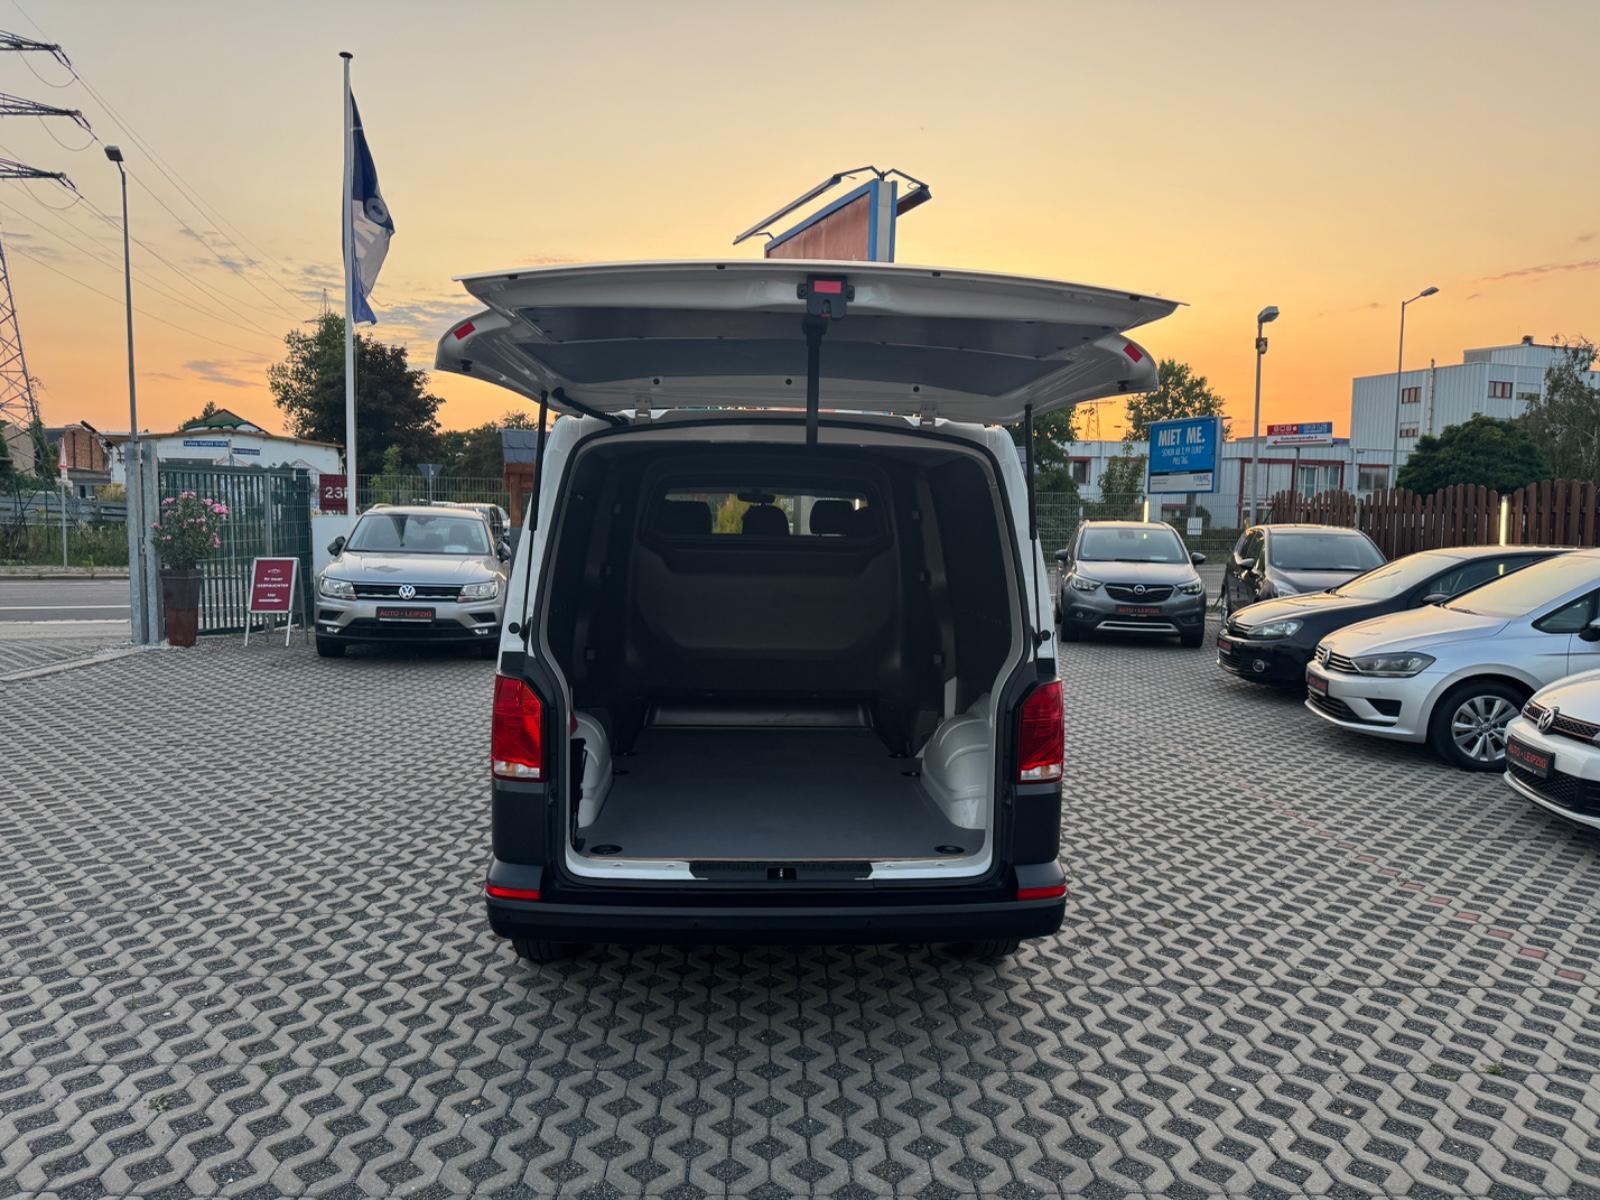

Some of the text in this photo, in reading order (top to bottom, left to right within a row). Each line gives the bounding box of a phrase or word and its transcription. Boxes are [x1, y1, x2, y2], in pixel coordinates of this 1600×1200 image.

[1158, 426, 1206, 447] MIET ME.
[379, 609, 432, 618] AUTO LEIPZIG
